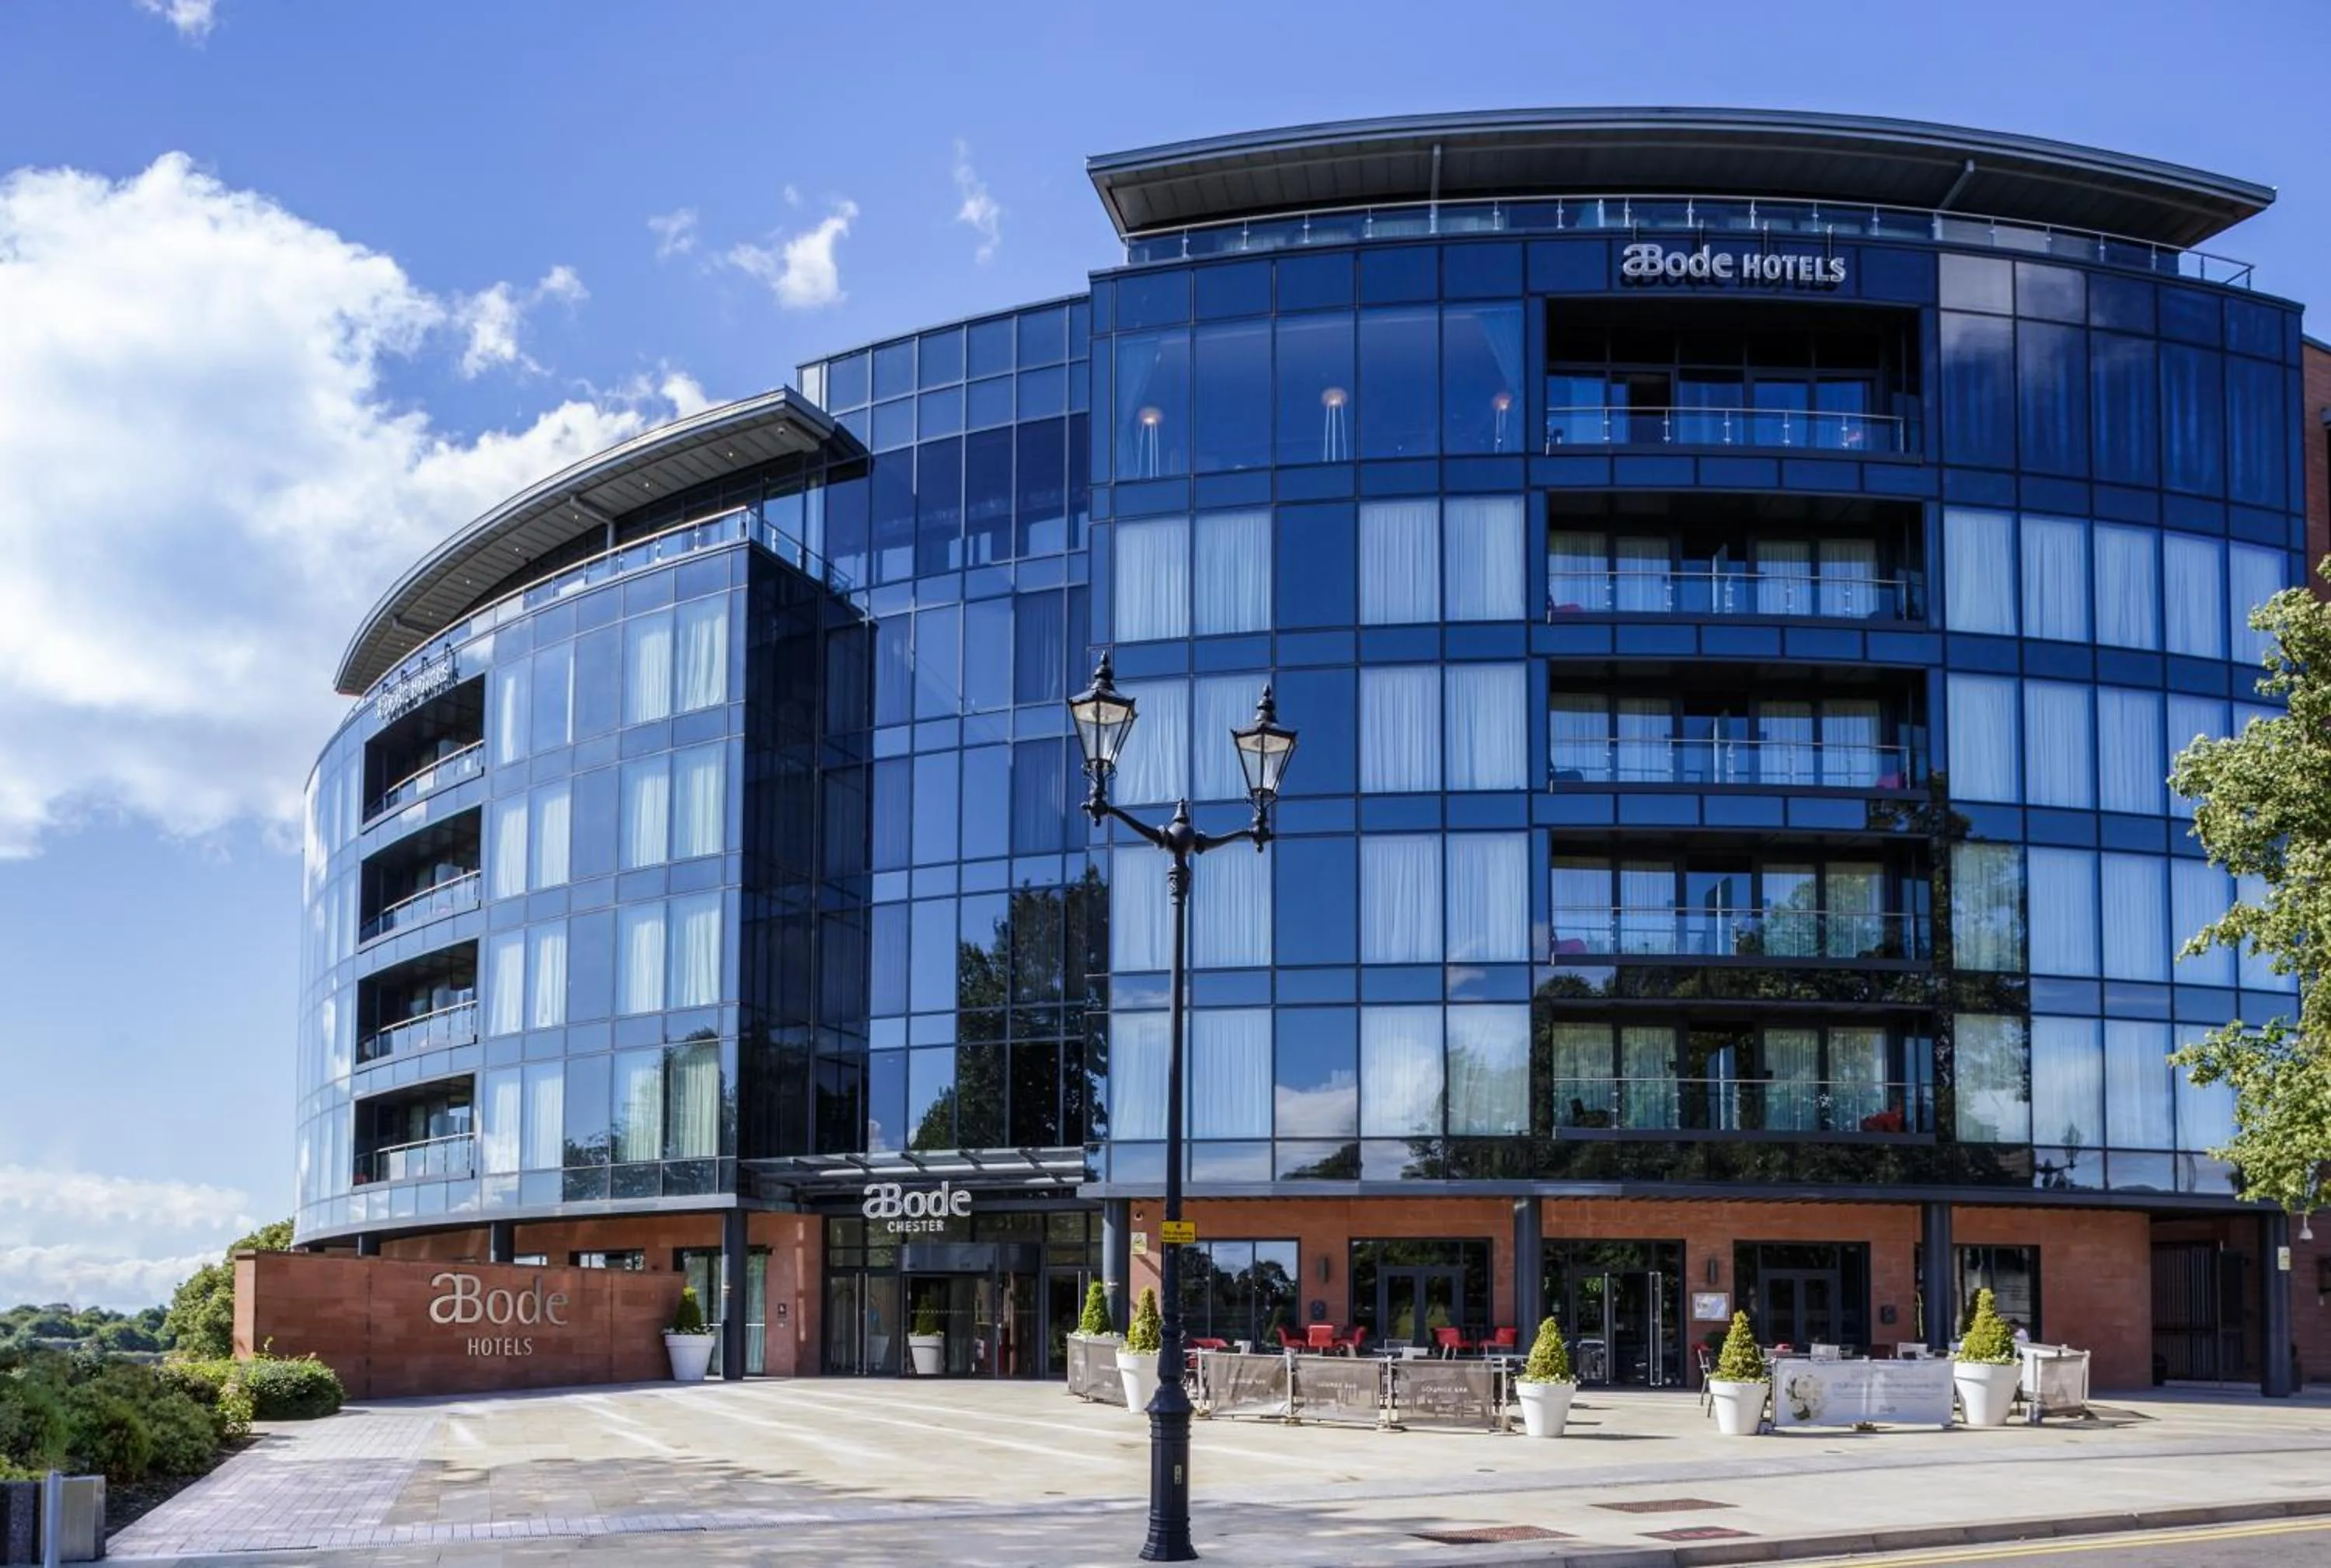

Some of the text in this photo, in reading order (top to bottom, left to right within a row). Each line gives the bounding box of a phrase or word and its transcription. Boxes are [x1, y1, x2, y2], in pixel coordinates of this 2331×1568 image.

[1743, 253, 1846, 282] HOTELS
[887, 1219, 945, 1233] CHESTER
[468, 1336, 533, 1357] HOTELS
